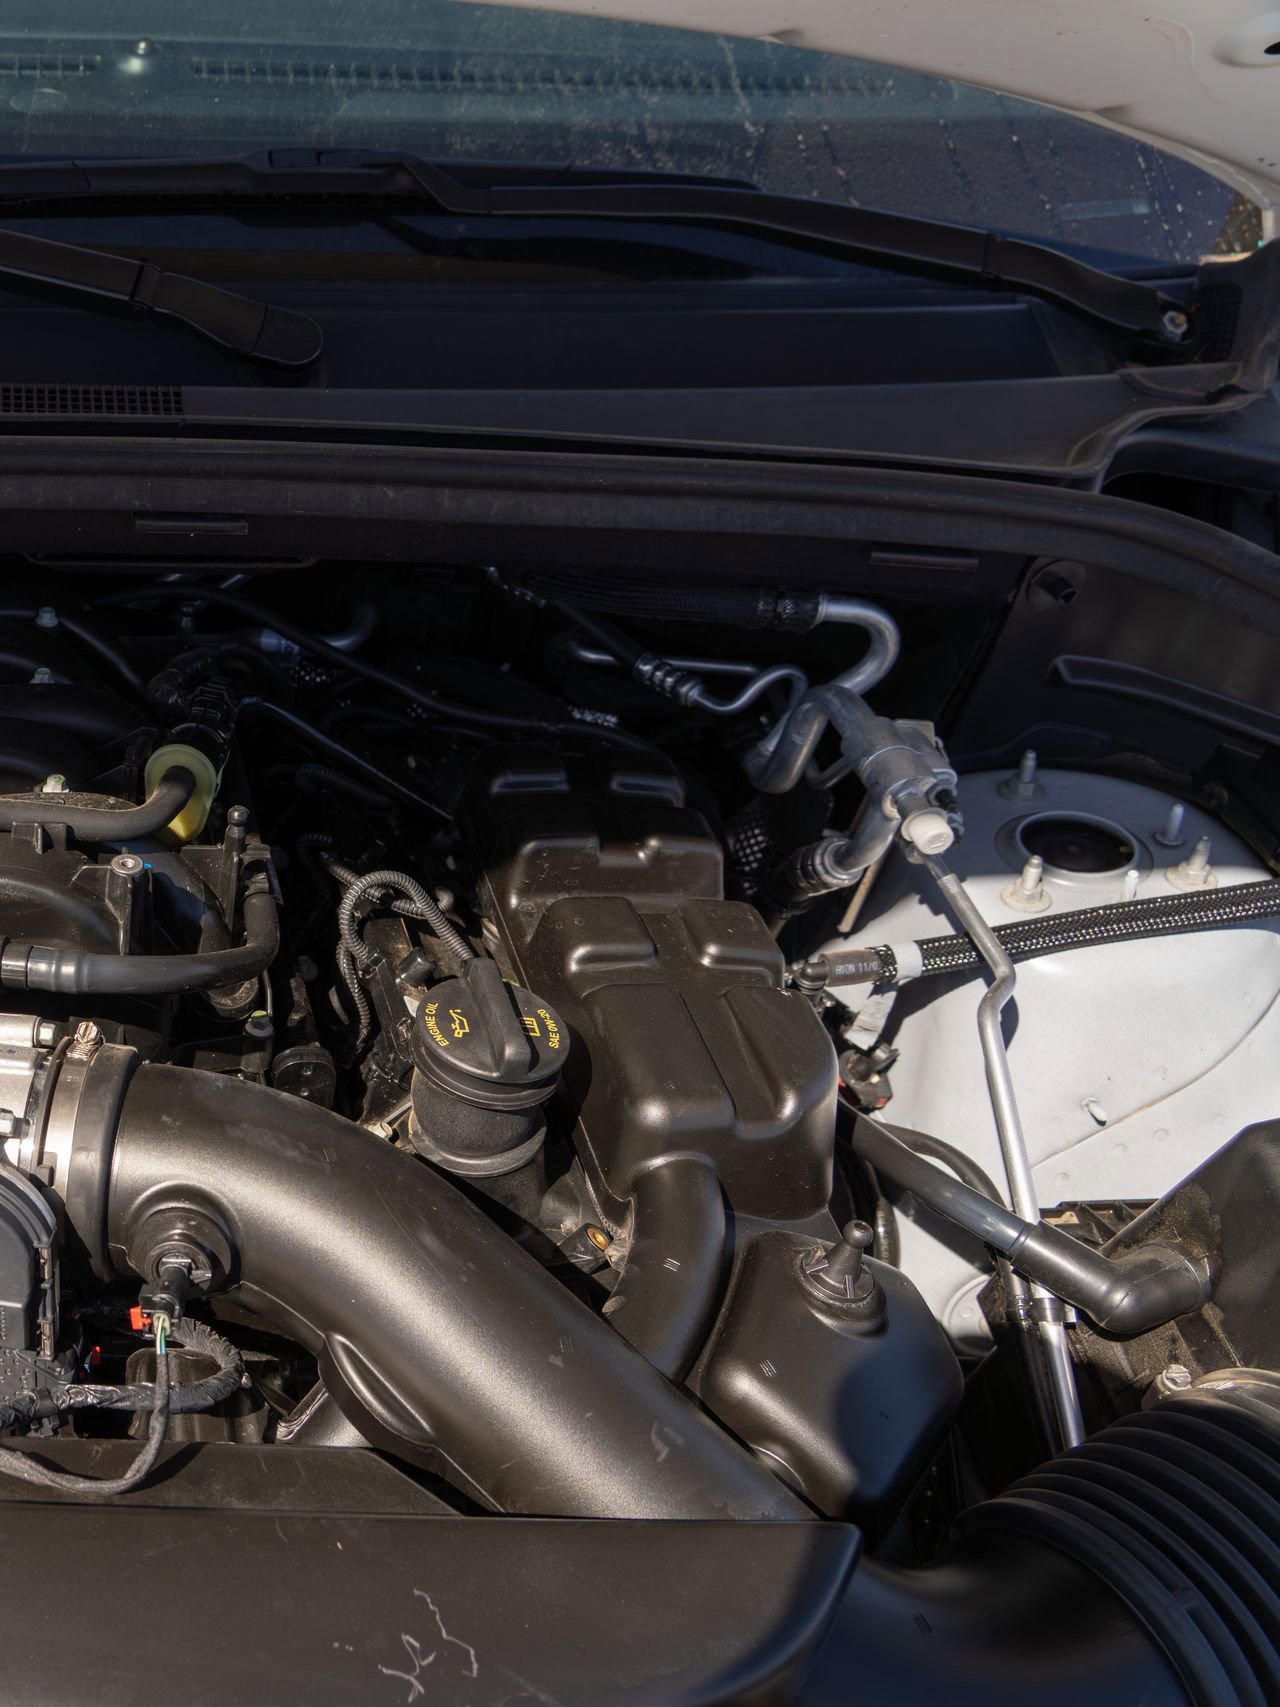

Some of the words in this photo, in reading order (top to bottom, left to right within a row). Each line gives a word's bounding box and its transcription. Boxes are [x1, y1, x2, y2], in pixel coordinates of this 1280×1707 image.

[426, 1002, 439, 1014] OIL
[537, 1009, 559, 1032] 0W-20
[426, 1015, 450, 1047] ENGINE
[548, 1031, 561, 1049] SAE
